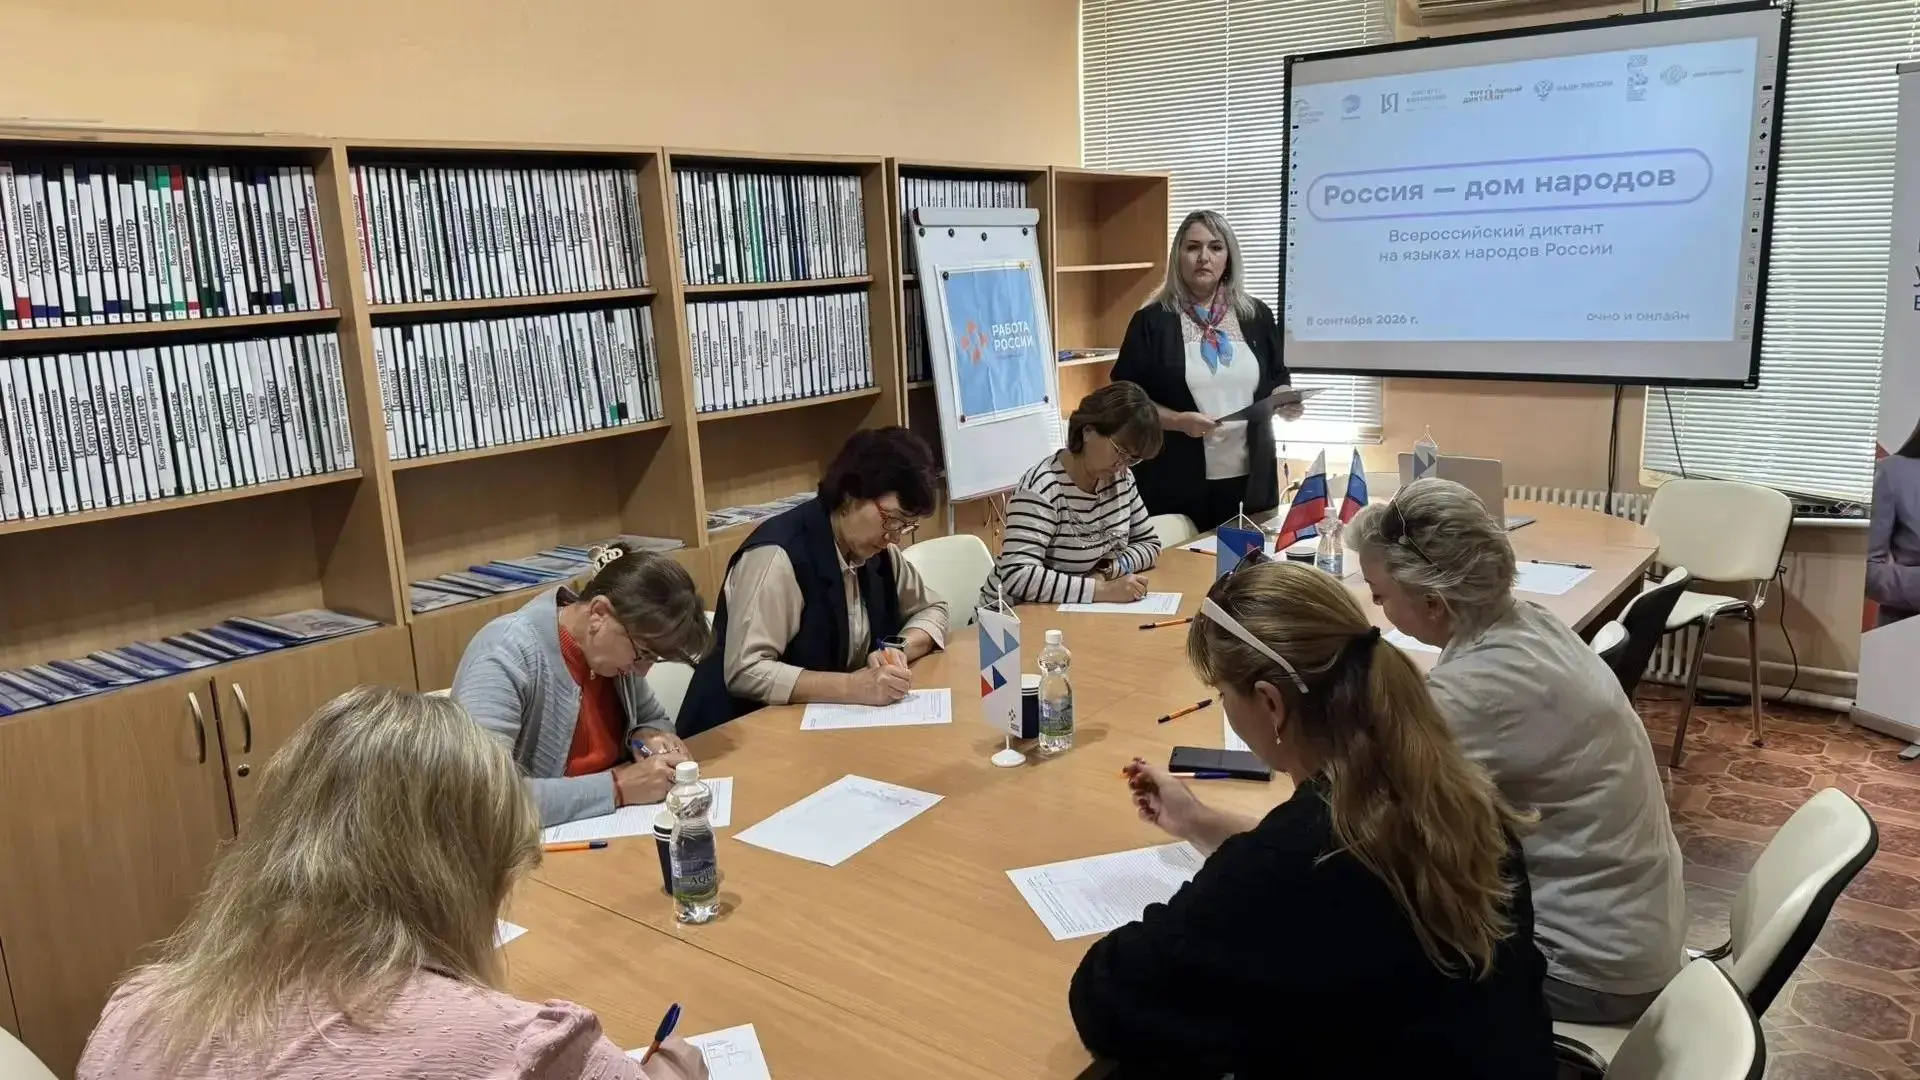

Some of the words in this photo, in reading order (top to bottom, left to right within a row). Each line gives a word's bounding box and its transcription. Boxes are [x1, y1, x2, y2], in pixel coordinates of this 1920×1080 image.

[1324, 184, 1424, 206] Россия
[1464, 178, 1524, 200] дом
[1535, 168, 1676, 197] народов
[165, 202, 175, 230] трамвая
[225, 200, 243, 274] Врач-терапевт
[287, 218, 298, 253] Гончар
[298, 208, 313, 260] Горничная
[554, 216, 562, 242] Повар
[1389, 224, 1525, 244] Всероссийский
[1529, 223, 1603, 239] диктант
[23, 204, 42, 277] Арматурщик
[36, 201, 52, 275] Асфальтобетонщик
[57, 226, 71, 273] Аудитор
[87, 232, 99, 272] Бармен
[100, 218, 113, 273] Бетонщик
[115, 225, 126, 268] Бондарь
[126, 219, 141, 273] Бухгалтер
[169, 233, 178, 266] Водитель
[213, 195, 233, 283] Врач-стоматолог
[516, 242, 525, 275] Педагог
[1379, 251, 1398, 263] на
[1403, 248, 1460, 262] языках
[1464, 245, 1538, 261] народов
[1545, 243, 1613, 257] России
[183, 249, 193, 282] Водитель
[991, 320, 1031, 337] РАБОТА
[1316, 314, 1373, 327] сентября
[1376, 314, 1407, 325] 2026
[1410, 315, 1419, 325] г.
[1586, 312, 1620, 321] очно
[1624, 312, 1632, 320] и
[1636, 310, 1690, 321] онлайн
[619, 343, 631, 386] Стеклодув
[628, 349, 637, 378] Столяр
[691, 333, 700, 378] Архитектор
[702, 330, 710, 378] Библиотекарь
[712, 341, 720, 367] Брокер
[994, 335, 1034, 352] РОССИИ
[144, 366, 158, 409] маркетингу
[204, 362, 215, 388] кровель
[377, 350, 394, 431] Профконсультант
[389, 368, 401, 412] Психолог
[401, 368, 412, 412] Птицевод
[418, 355, 431, 419] Радиомеханик
[441, 380, 447, 388] по
[457, 363, 468, 401] Рыболов
[94, 385, 105, 415] банке
[137, 396, 150, 445] Кондитер
[151, 411, 158, 420] по
[170, 392, 184, 442] Консьерж
[209, 391, 219, 422] стальных
[230, 387, 246, 435] Лесничий
[246, 393, 256, 425] Маляр
[267, 380, 280, 434] Массажист
[280, 387, 291, 423] Матрос
[21, 398, 38, 470] Инженер-строитель
[68, 397, 84, 459] Инкассатор
[79, 400, 98, 456] Картограф
[109, 391, 124, 456] Коммерсант
[121, 385, 138, 459] Коммивояжер
[100, 427, 112, 464] Кассир
[153, 423, 166, 470] Консультант
[214, 424, 227, 465] Кровельщик
